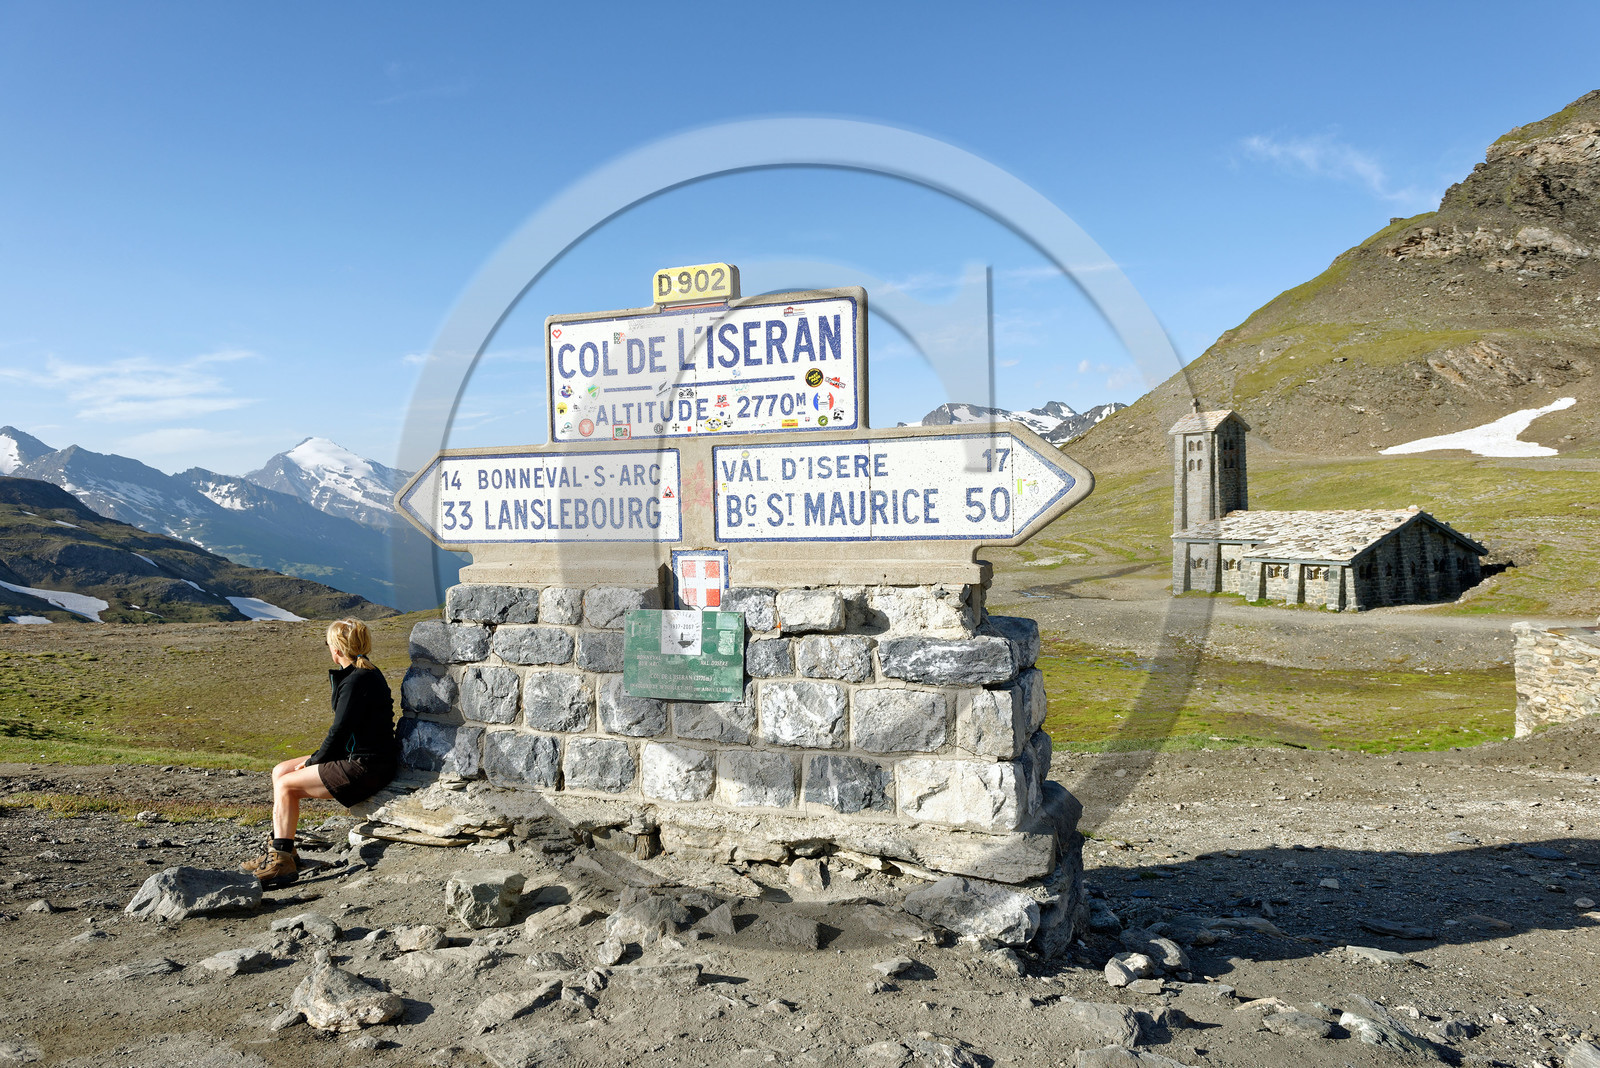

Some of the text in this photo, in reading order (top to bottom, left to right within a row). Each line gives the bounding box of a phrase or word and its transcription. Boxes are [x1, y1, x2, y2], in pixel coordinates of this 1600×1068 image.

[557, 314, 842, 380] COL DE L'ISERAN
[596, 398, 710, 426] ALTITUDE
[441, 470, 462, 490] 14
[722, 448, 1011, 482] VAL D'ISERE 17
[442, 496, 662, 530] 33 LANSLEBOURG
[804, 488, 940, 526] MAURICE
[965, 487, 1011, 523] 50
